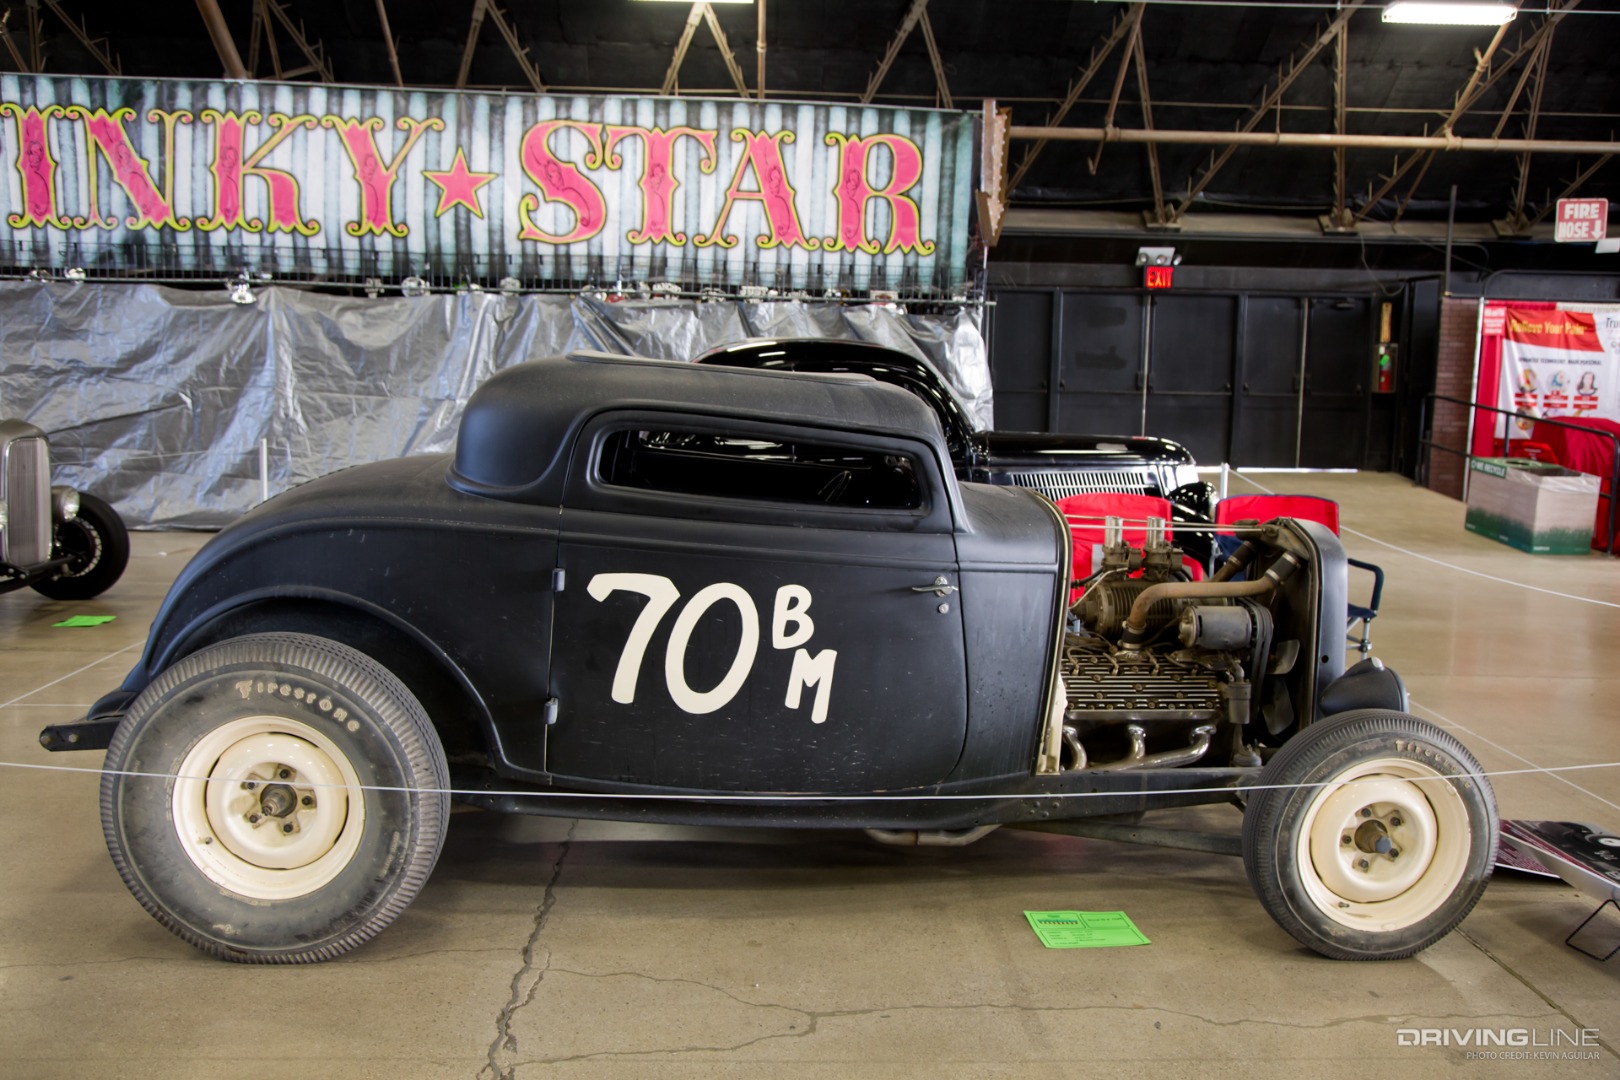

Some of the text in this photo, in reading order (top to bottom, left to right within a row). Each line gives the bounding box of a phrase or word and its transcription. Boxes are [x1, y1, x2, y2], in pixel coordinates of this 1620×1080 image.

[517, 119, 936, 256] STAR
[1564, 203, 1600, 219] FIRE
[1558, 221, 1590, 238] HOSE
[1147, 269, 1172, 287] EXIT
[587, 572, 760, 714] 70
[772, 584, 815, 650] B
[235, 679, 360, 732] Firestone
[784, 648, 838, 724] M
